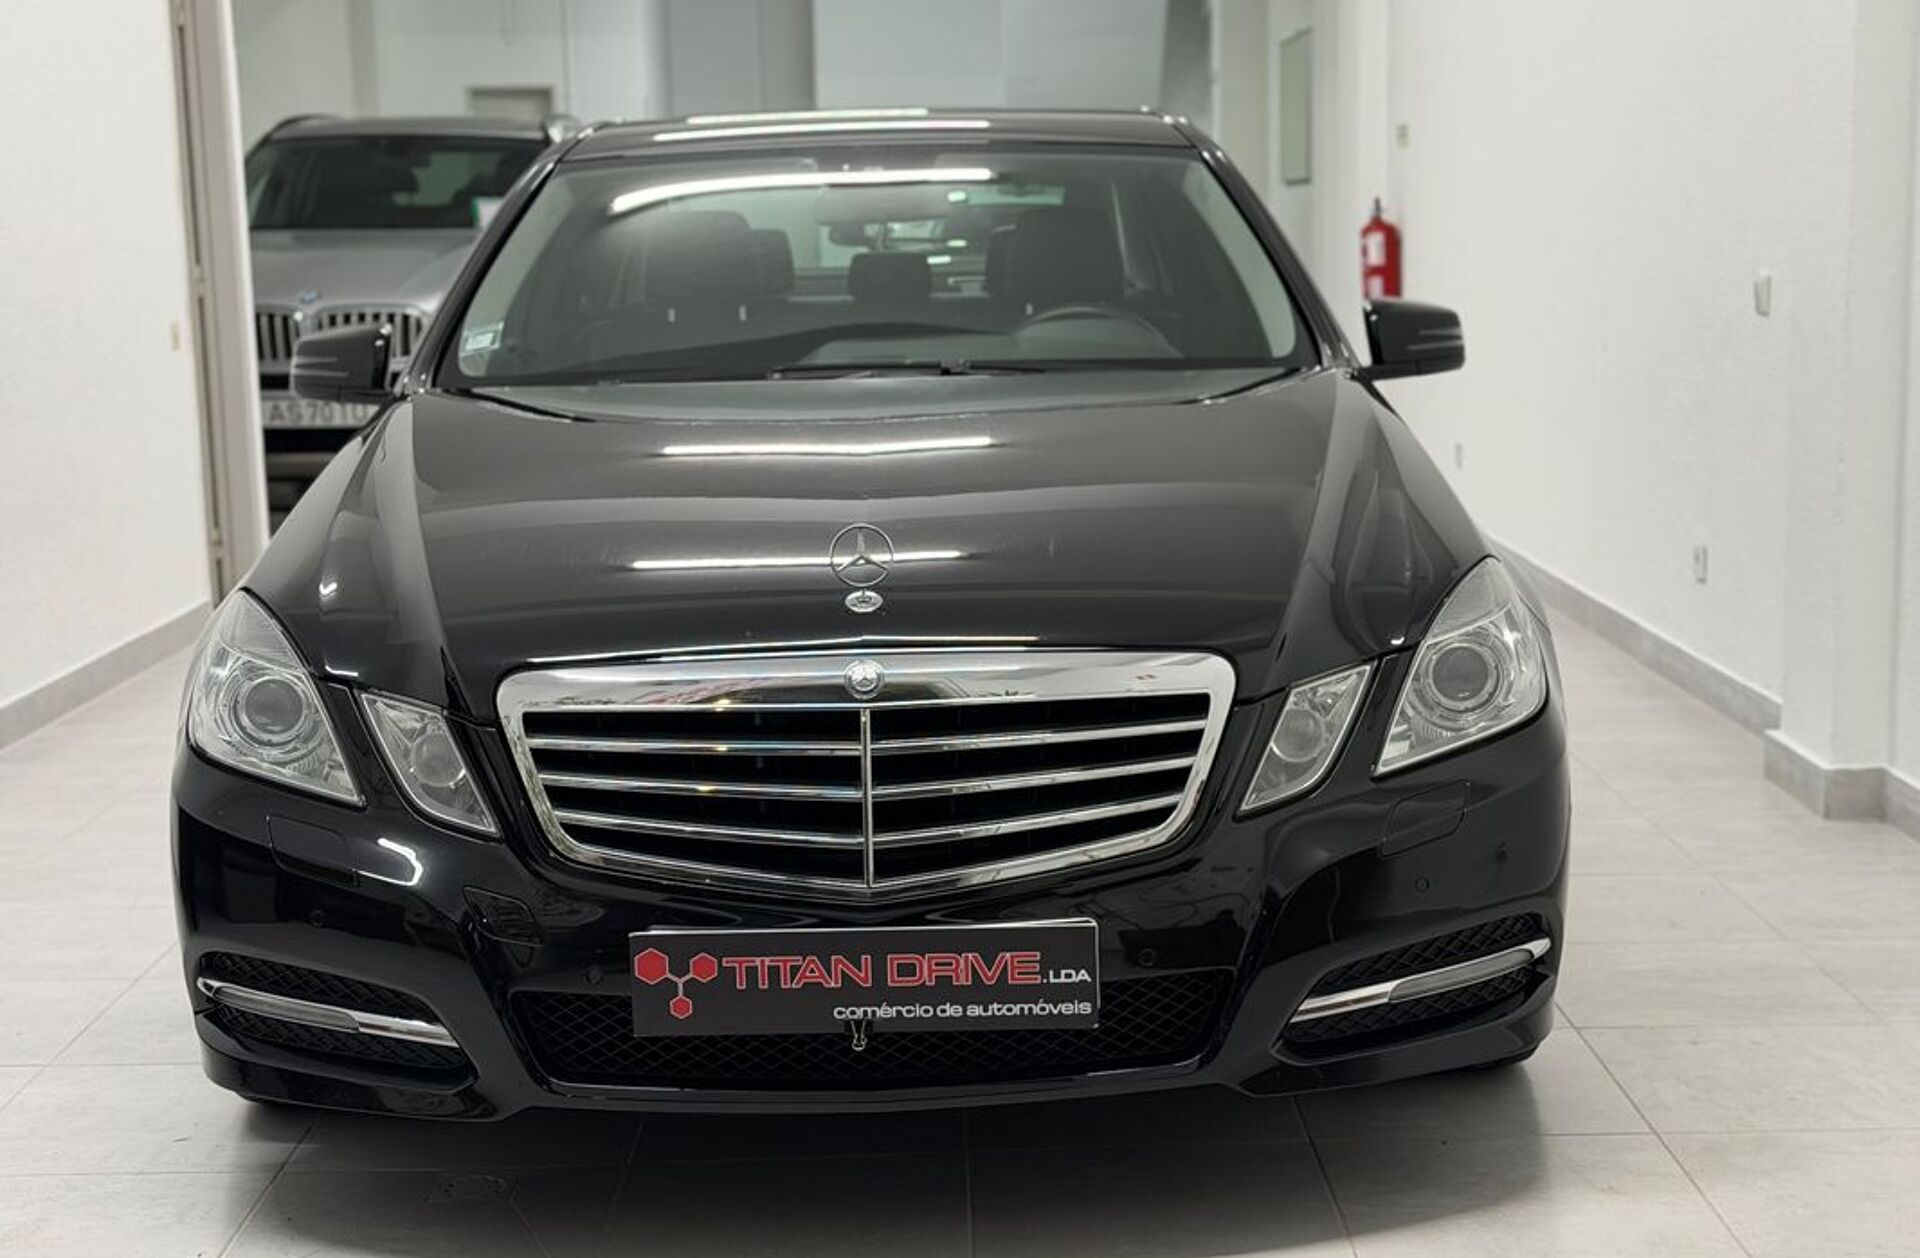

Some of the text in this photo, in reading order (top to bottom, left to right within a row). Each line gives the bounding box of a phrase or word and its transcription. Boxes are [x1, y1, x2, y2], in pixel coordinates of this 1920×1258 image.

[722, 954, 873, 989] TITAN
[832, 998, 1092, 1020] comércio de automóveis
